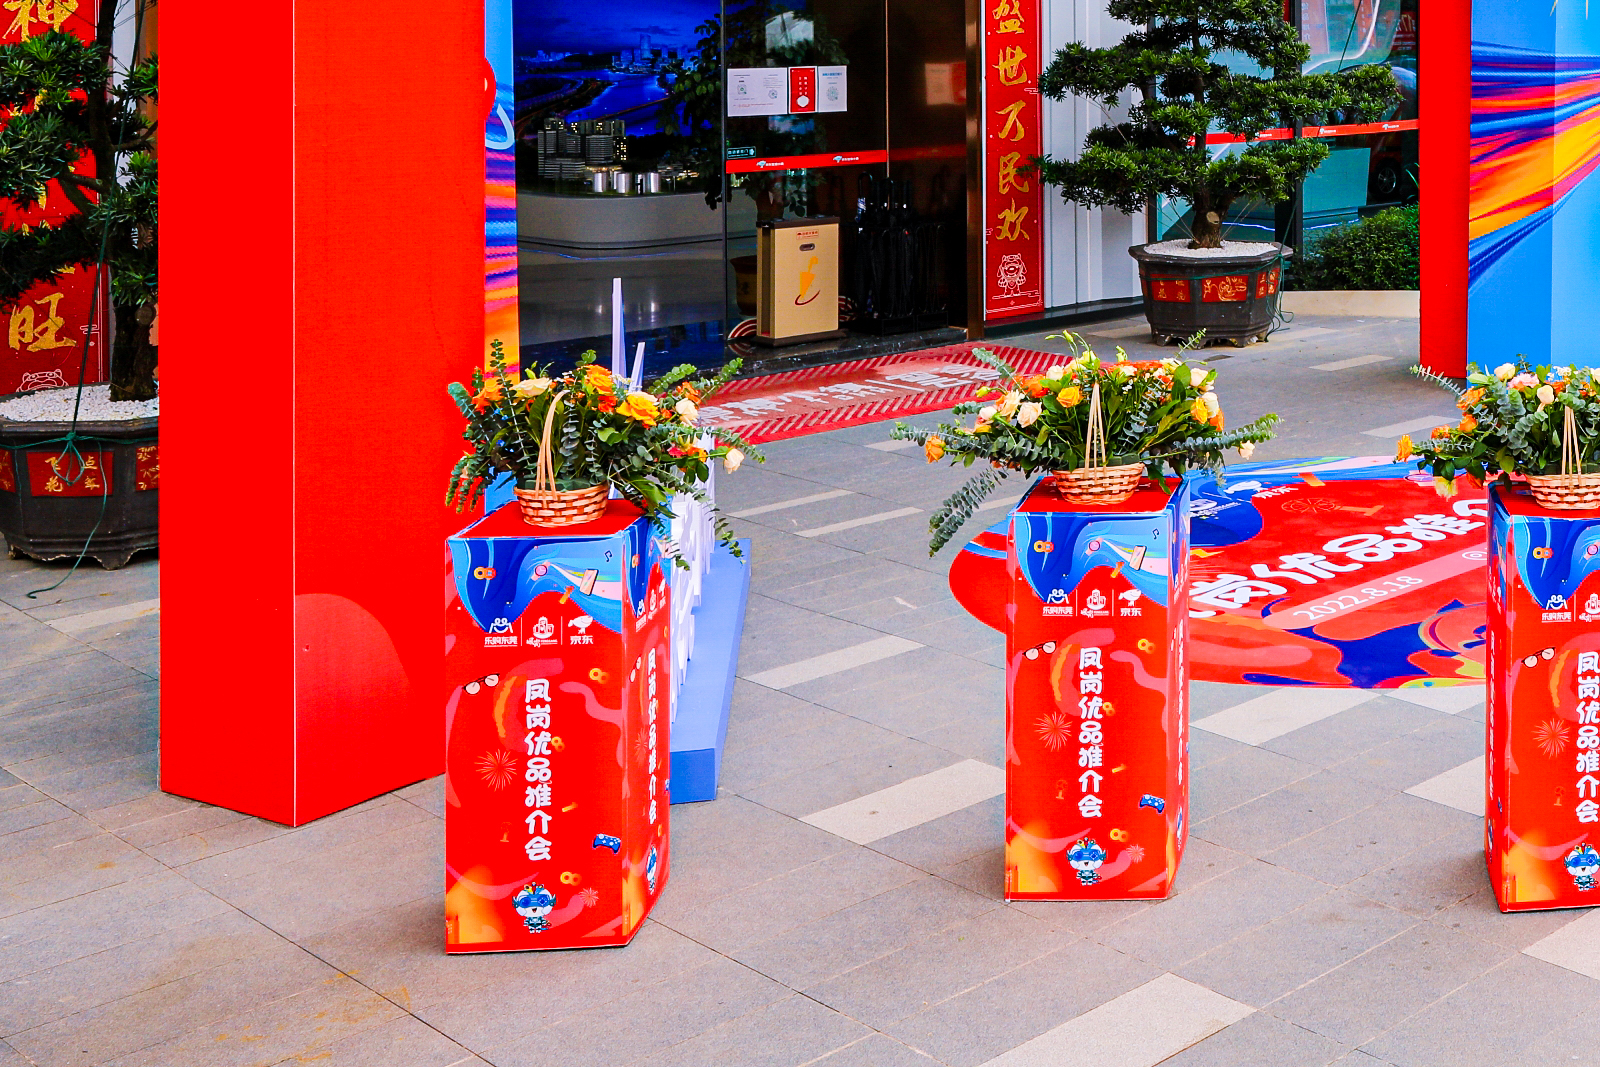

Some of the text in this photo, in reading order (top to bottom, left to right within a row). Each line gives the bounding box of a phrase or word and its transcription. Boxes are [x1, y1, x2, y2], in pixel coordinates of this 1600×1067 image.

[570, 635, 594, 645] 京东
[1121, 608, 1142, 617] 京东
[1292, 575, 1423, 622] 2022.8.18
[524, 679, 552, 861] 凤岗优品推介会
[1078, 647, 1104, 818] 凤岗优品推介会
[1576, 652, 1600, 823] 凤岗优品推介会
